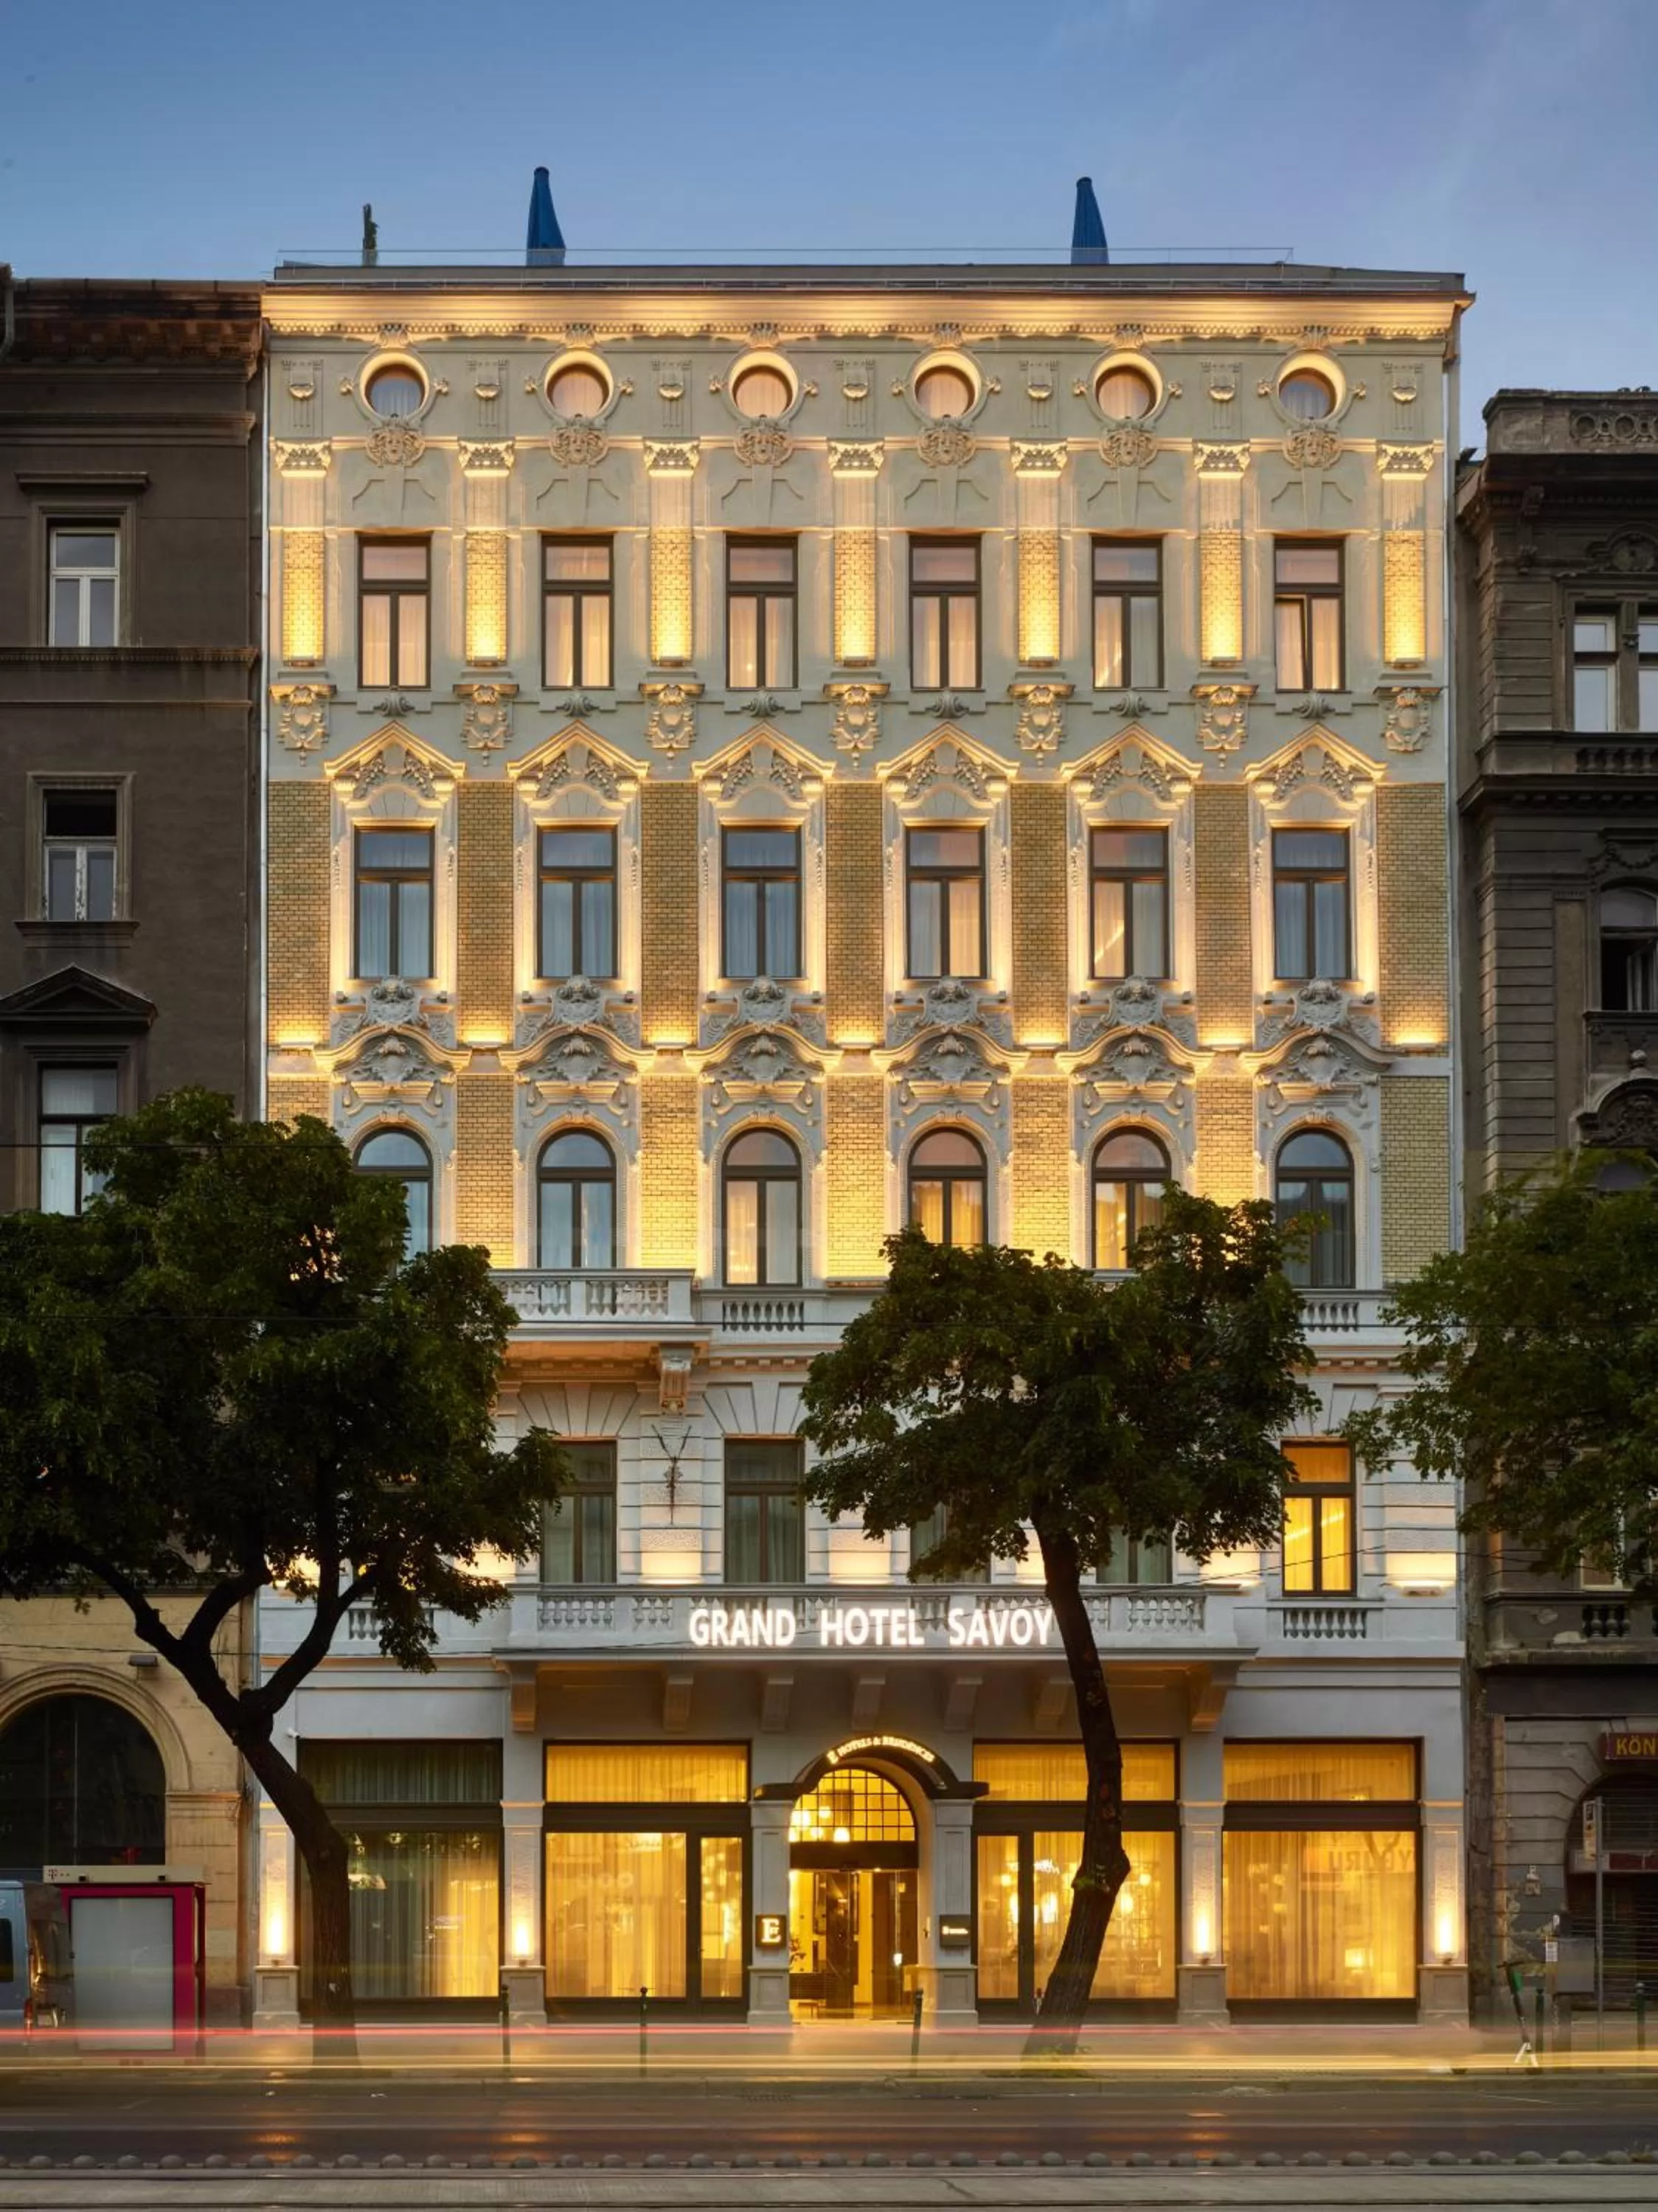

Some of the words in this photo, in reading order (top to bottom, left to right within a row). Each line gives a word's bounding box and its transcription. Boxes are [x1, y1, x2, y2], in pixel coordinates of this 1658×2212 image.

[689, 1608, 796, 1646] GRAND
[820, 1608, 924, 1646] HOTEL
[948, 1608, 1052, 1646] SAVOY
[837, 1737, 873, 1756] HOTELS
